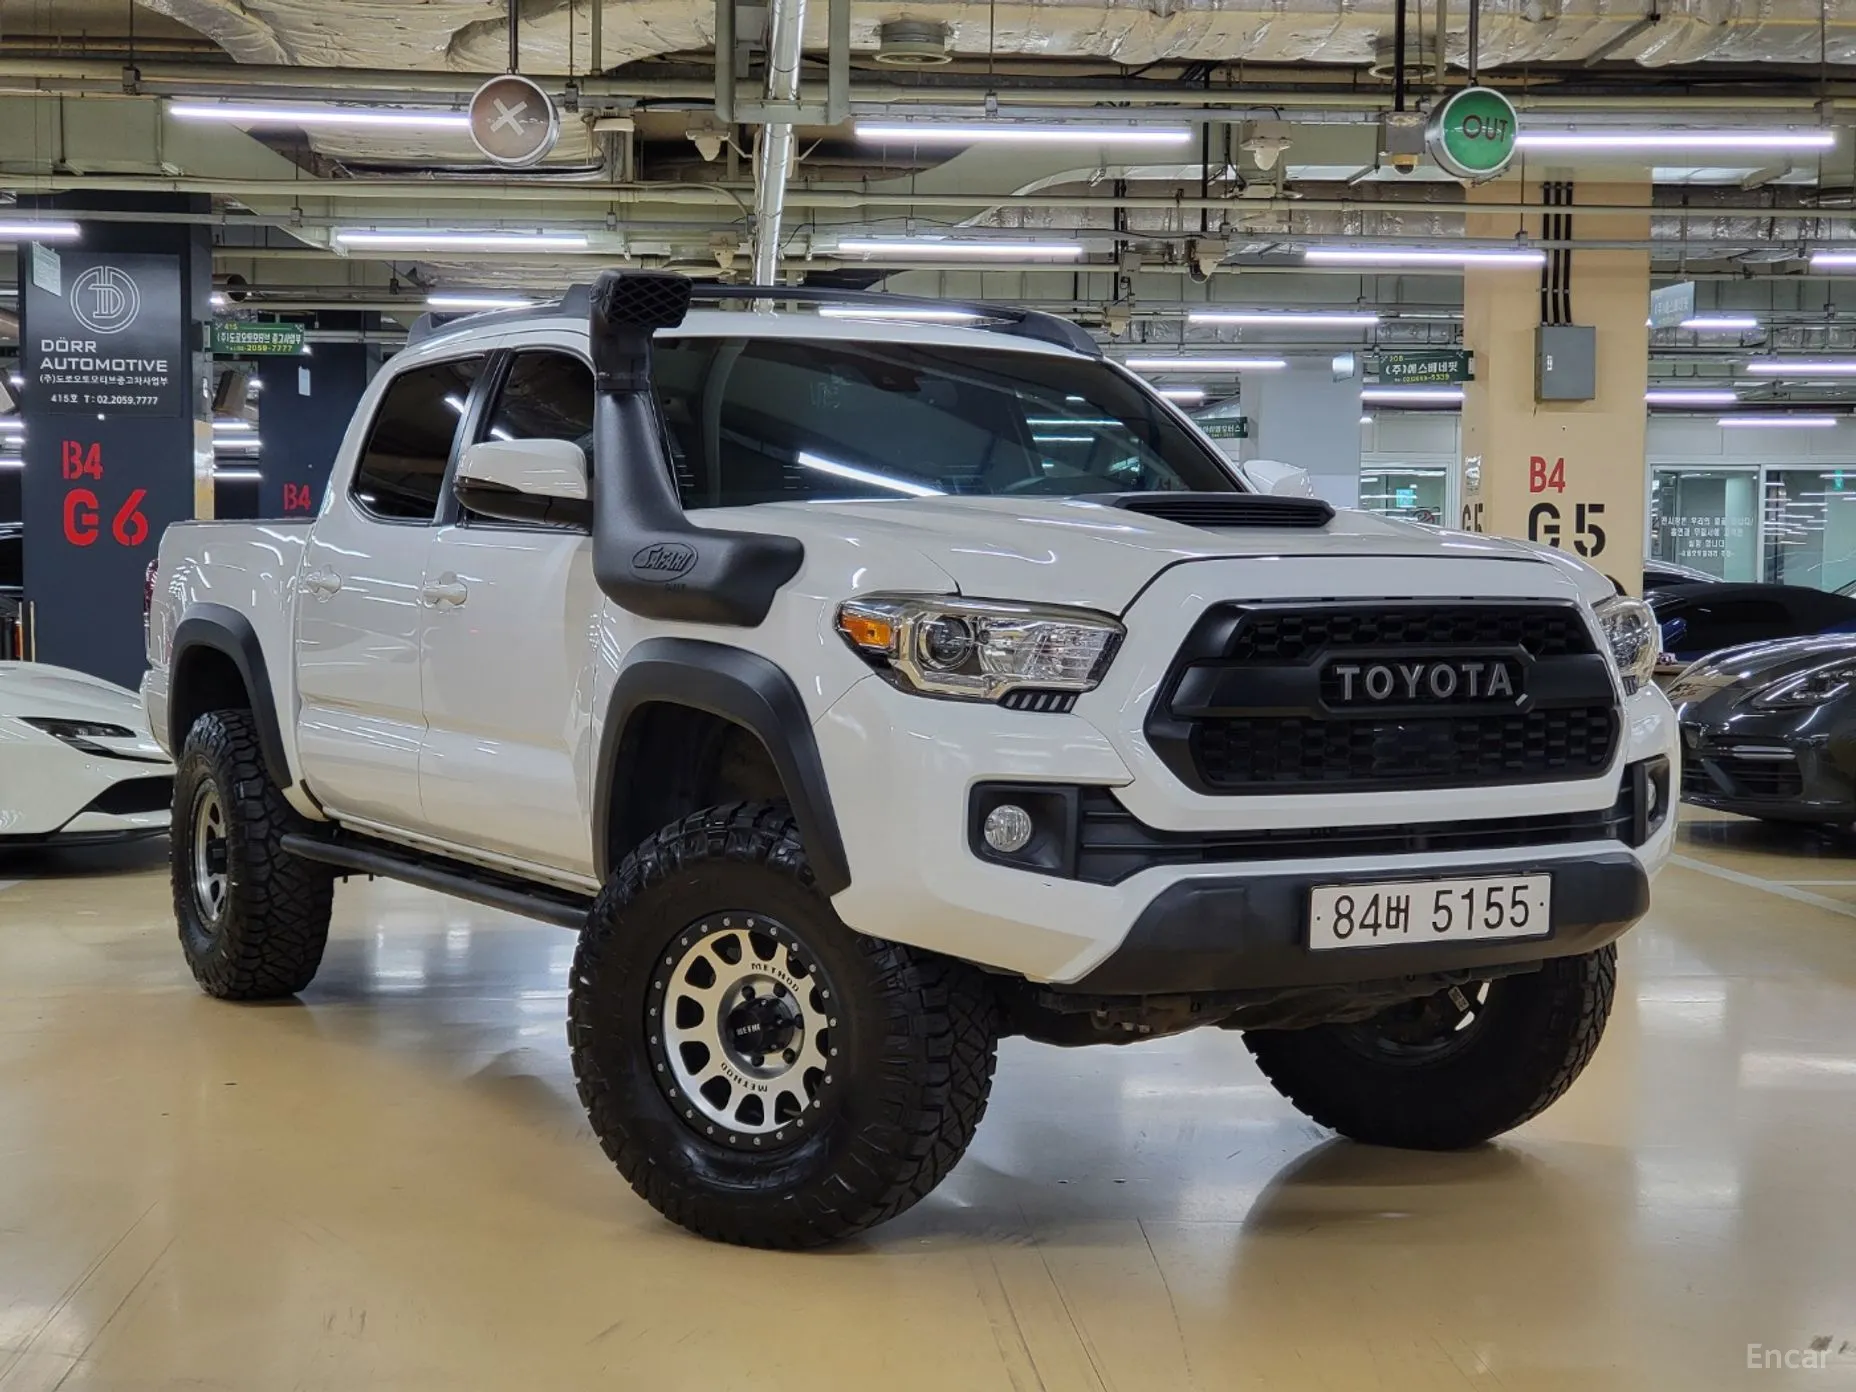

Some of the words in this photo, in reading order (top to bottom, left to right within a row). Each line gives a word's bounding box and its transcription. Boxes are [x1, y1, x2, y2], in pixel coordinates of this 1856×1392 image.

[1462, 114, 1508, 142] OUT
[41, 336, 97, 353] DÖRR
[40, 357, 168, 373] AUTOMOTIVE
[62, 441, 103, 480] B4
[1530, 456, 1566, 493] B4
[283, 483, 311, 511] B4
[1335, 663, 1514, 701] TOYOTA
[1332, 893, 1411, 940] 84버
[1431, 885, 1530, 933] 5155
[751, 963, 799, 992] METHOD
[721, 1062, 768, 1092] METHOD
